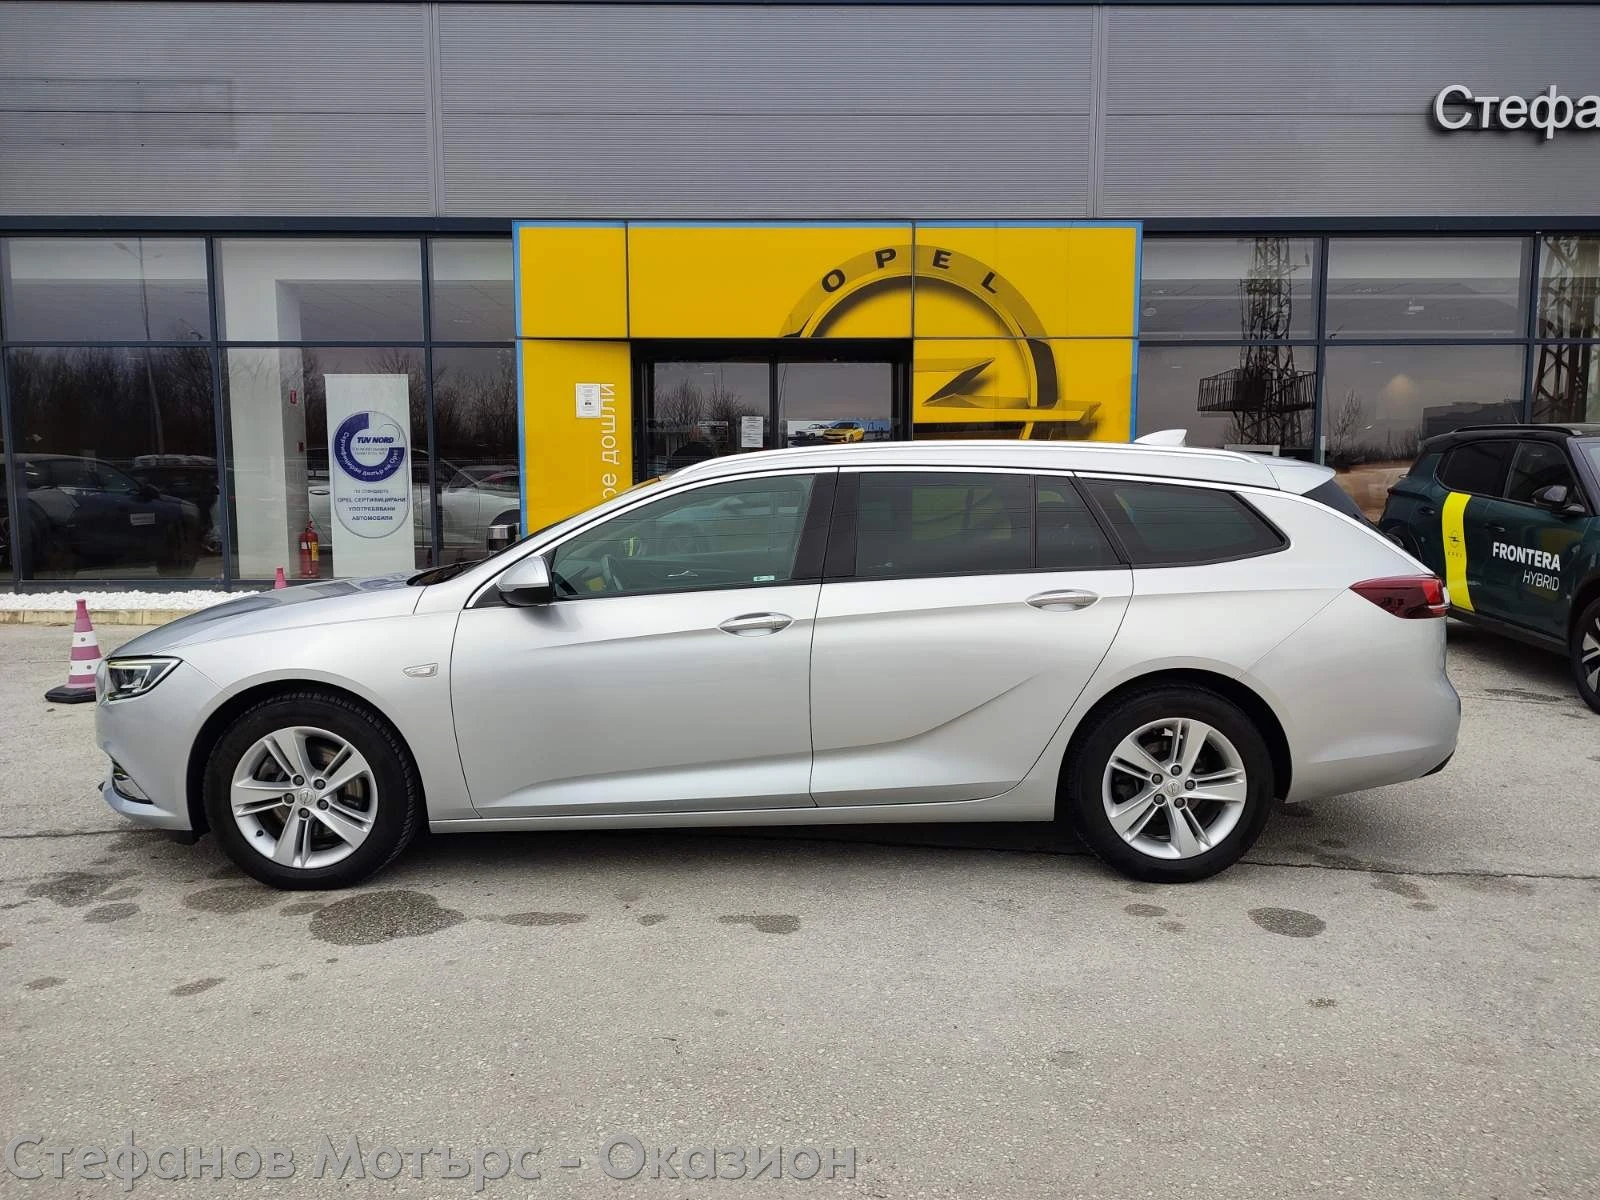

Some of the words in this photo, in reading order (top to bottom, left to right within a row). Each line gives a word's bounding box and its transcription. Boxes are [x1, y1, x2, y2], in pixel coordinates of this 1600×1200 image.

[1435, 84, 1600, 140] Стефа
[821, 248, 999, 294] OPEL
[372, 436, 394, 444] NORD
[601, 383, 620, 465] дошли
[1492, 541, 1561, 572] FRONTERA
[1522, 569, 1560, 592] HYBRID
